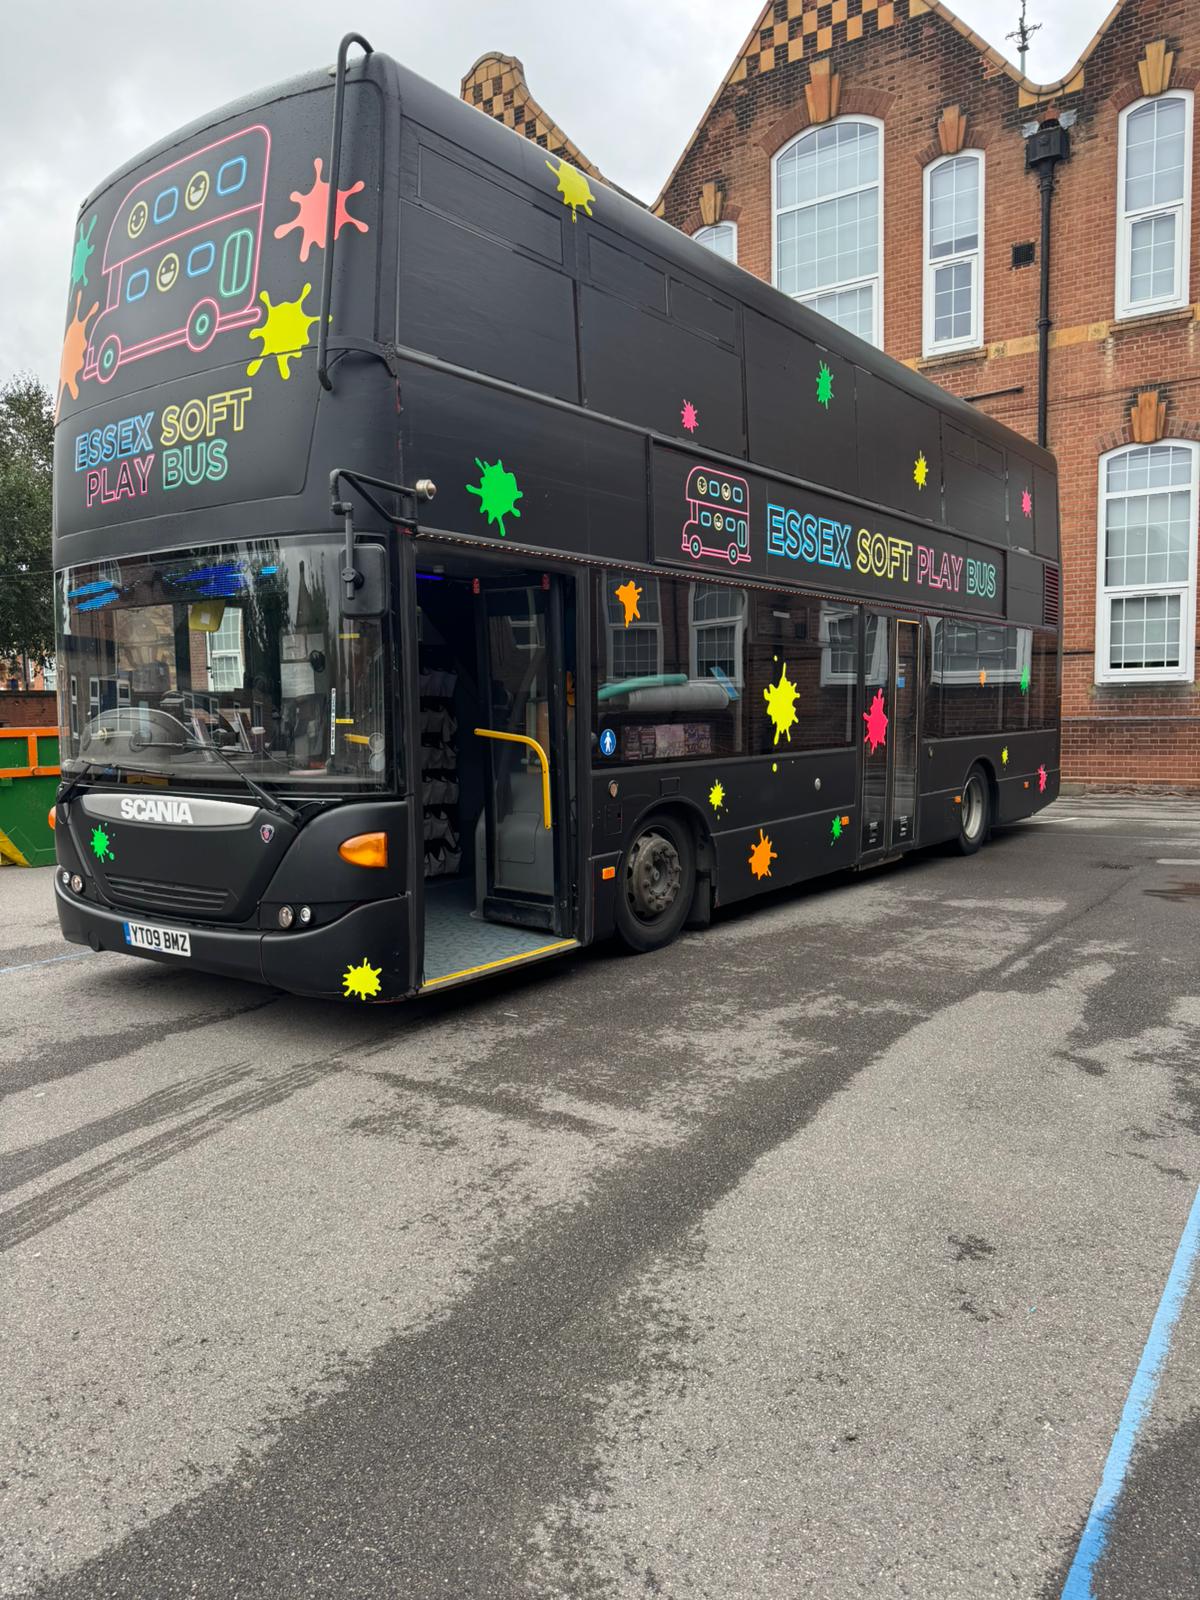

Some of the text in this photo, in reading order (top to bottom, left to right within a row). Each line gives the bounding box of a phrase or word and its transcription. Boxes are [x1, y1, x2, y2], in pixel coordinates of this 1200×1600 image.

[75, 387, 252, 472] ESSEX SOFT
[86, 438, 228, 507] PLAY BUS
[767, 503, 996, 599] ESSEX SOFT PLAY BUS
[121, 798, 194, 824] SCANIA
[131, 925, 188, 952] YT09 BMZ
